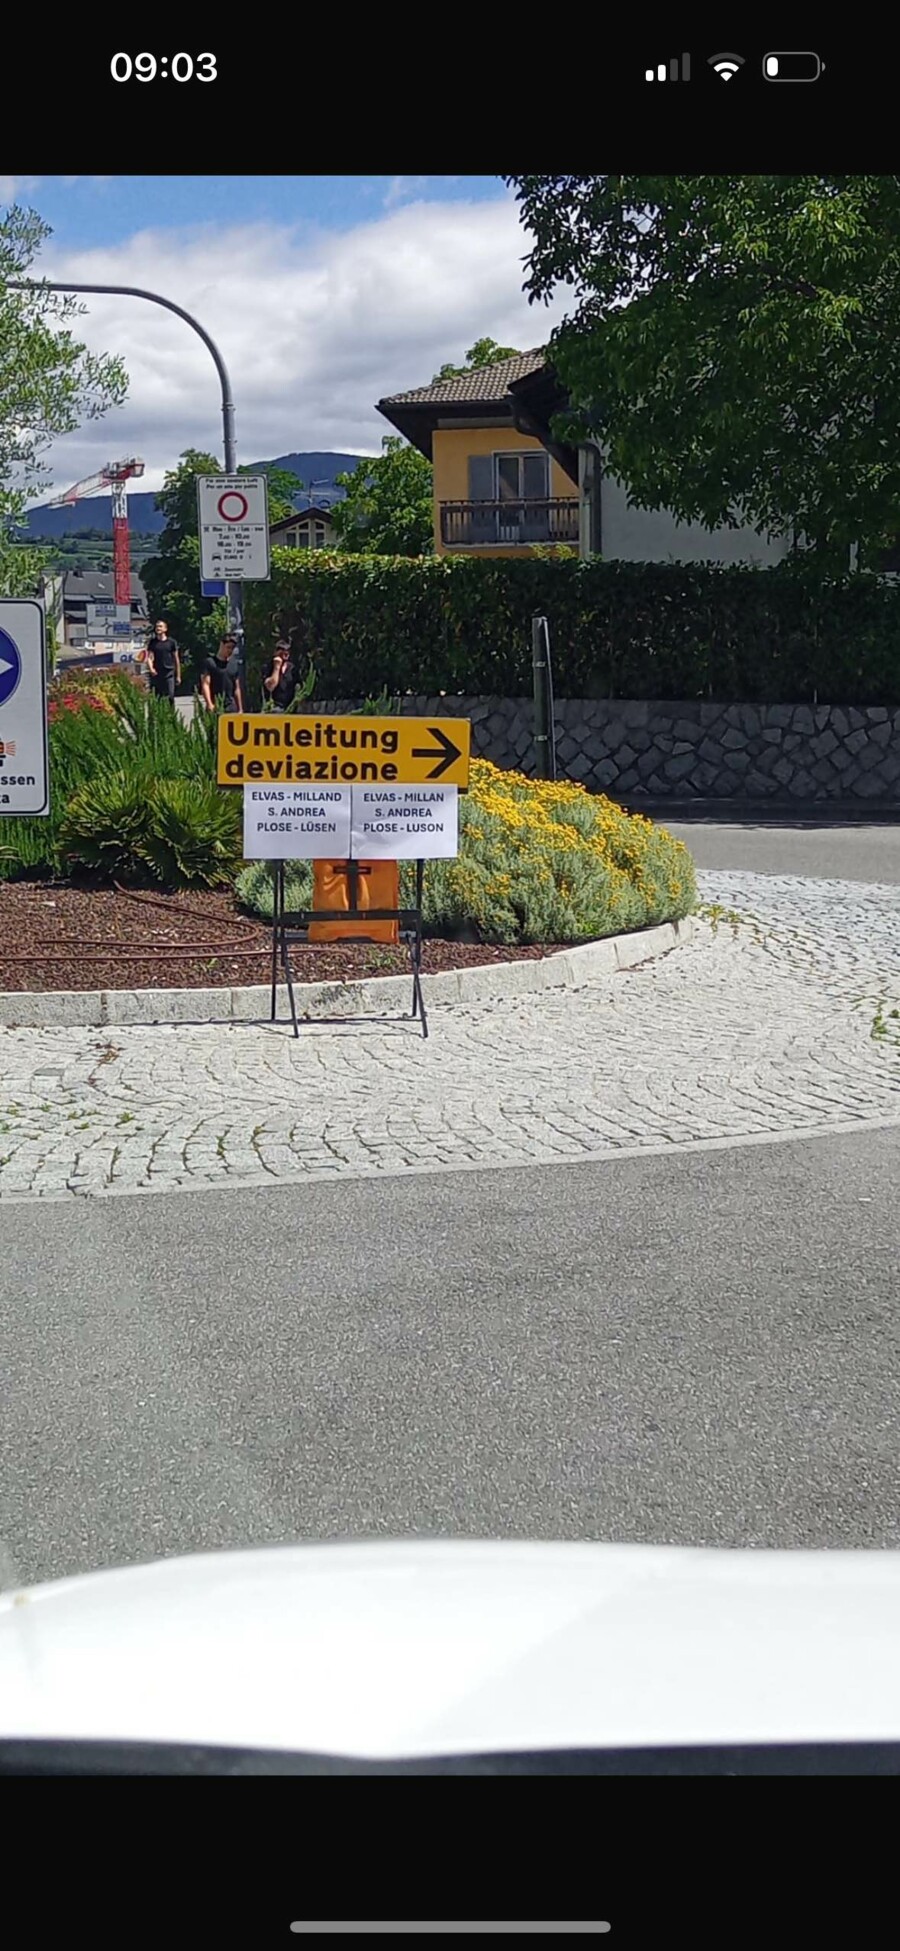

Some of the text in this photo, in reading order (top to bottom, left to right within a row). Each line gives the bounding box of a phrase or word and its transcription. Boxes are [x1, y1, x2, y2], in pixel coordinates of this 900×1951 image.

[227, 721, 398, 754] Umleitung
[225, 754, 398, 781] deviazione
[252, 791, 285, 801] ELVAS
[293, 792, 342, 801] MILLAND
[363, 792, 396, 802] ELVAS
[404, 792, 444, 802] MILLAN
[267, 807, 326, 817] S. ANDREA
[374, 808, 432, 817] S. ANDREA
[257, 822, 292, 832] PLOSE
[300, 821, 336, 832] LÜSEN
[363, 823, 398, 832] PLOSE
[406, 823, 444, 832] LUSON
